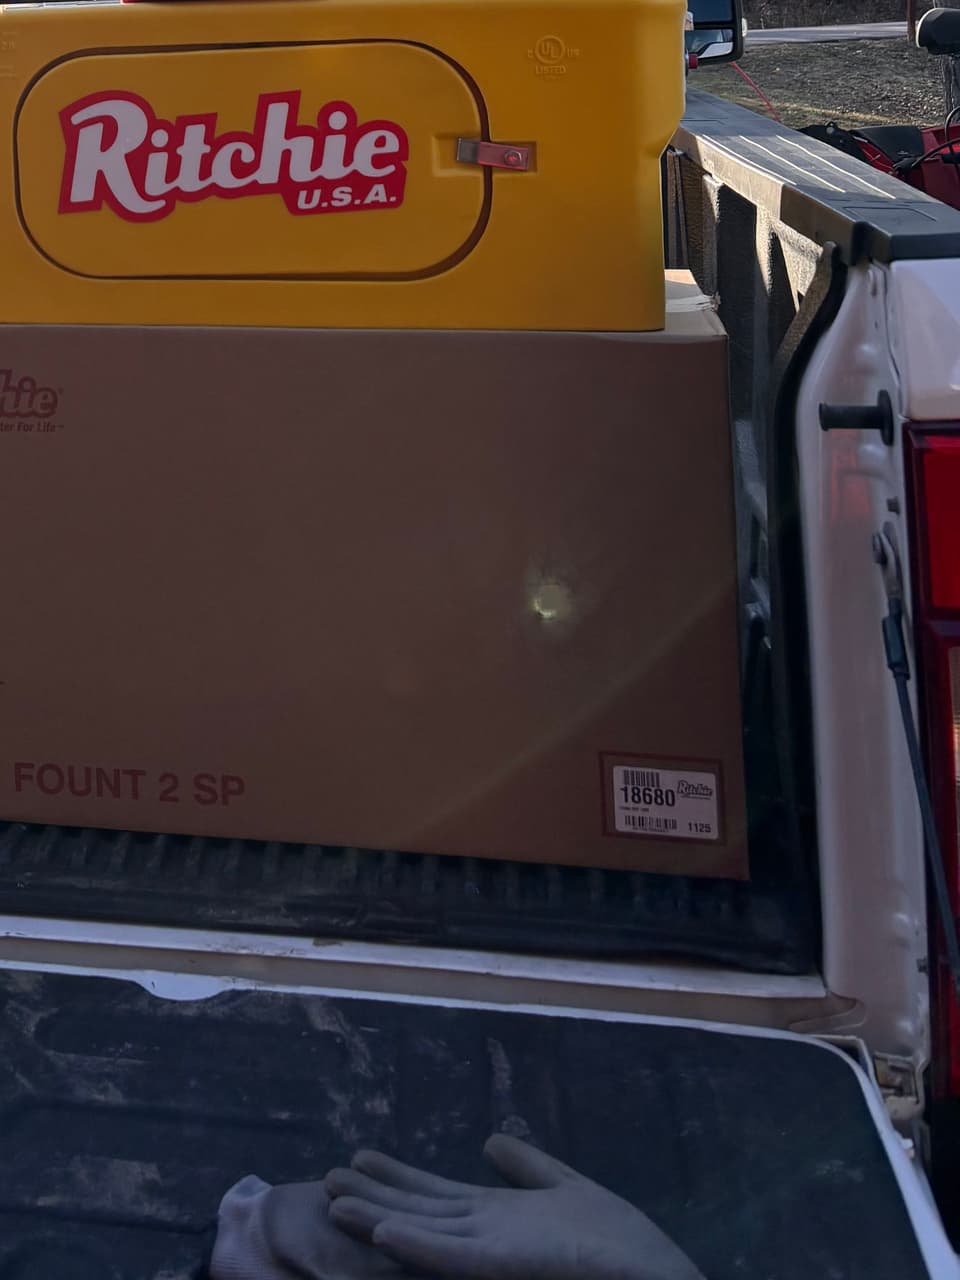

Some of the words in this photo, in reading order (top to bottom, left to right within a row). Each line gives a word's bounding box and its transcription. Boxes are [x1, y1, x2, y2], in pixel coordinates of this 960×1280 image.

[70, 99, 400, 213] Ritchie
[297, 183, 397, 210] U.S.A.
[17, 421, 35, 432] For
[14, 761, 147, 800] FOUNT
[158, 772, 180, 803] 2
[193, 772, 246, 806] SP
[620, 786, 676, 807] 18680
[688, 822, 712, 833] 1125
